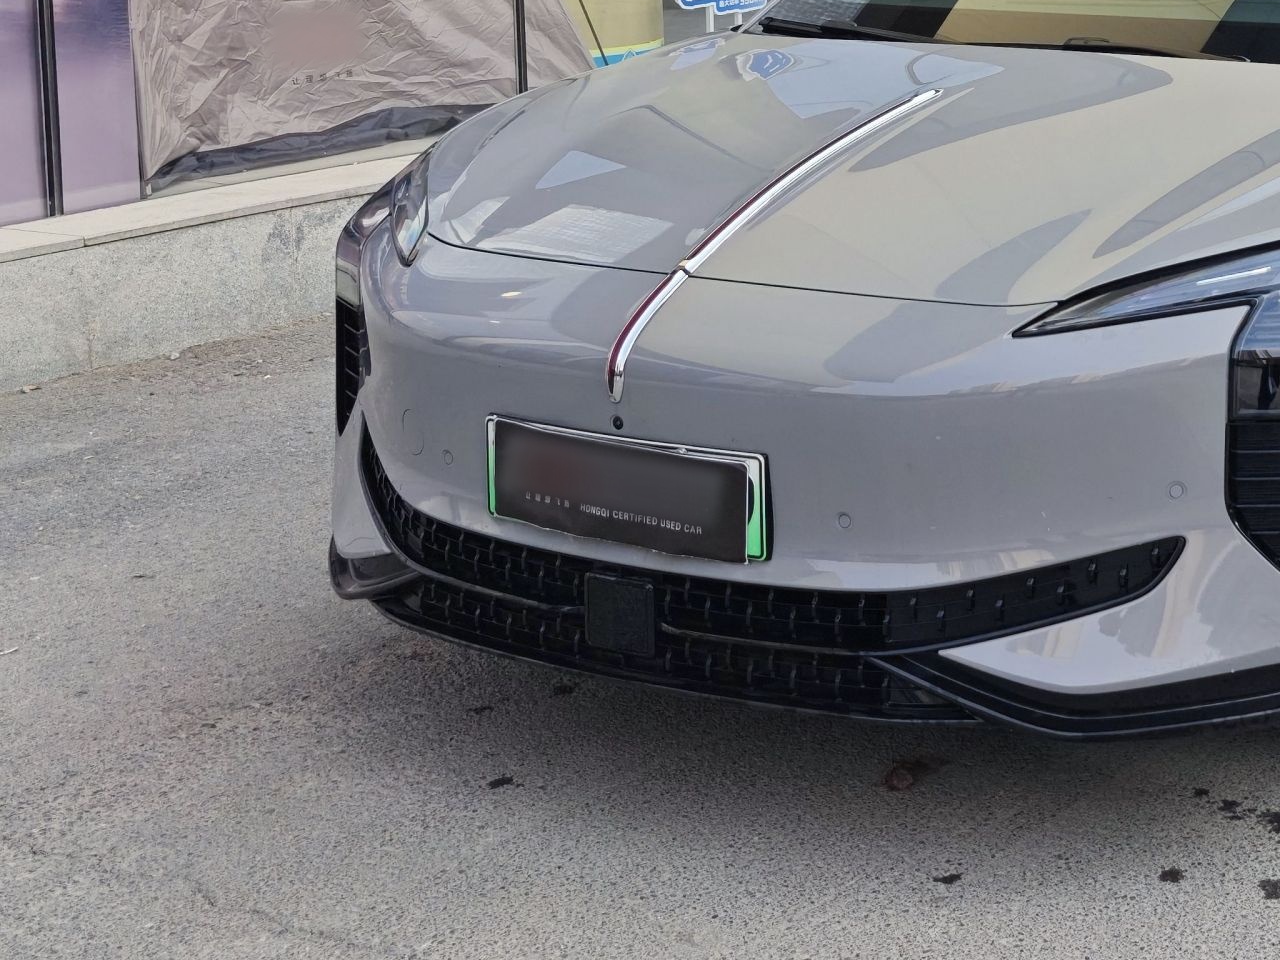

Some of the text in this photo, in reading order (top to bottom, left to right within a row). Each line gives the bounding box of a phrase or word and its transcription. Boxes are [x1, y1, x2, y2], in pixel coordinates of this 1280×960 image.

[580, 503, 610, 518] HONGQI
[612, 510, 658, 525] CERTIFIED
[660, 520, 682, 531] USED
[684, 524, 702, 535] CAR
